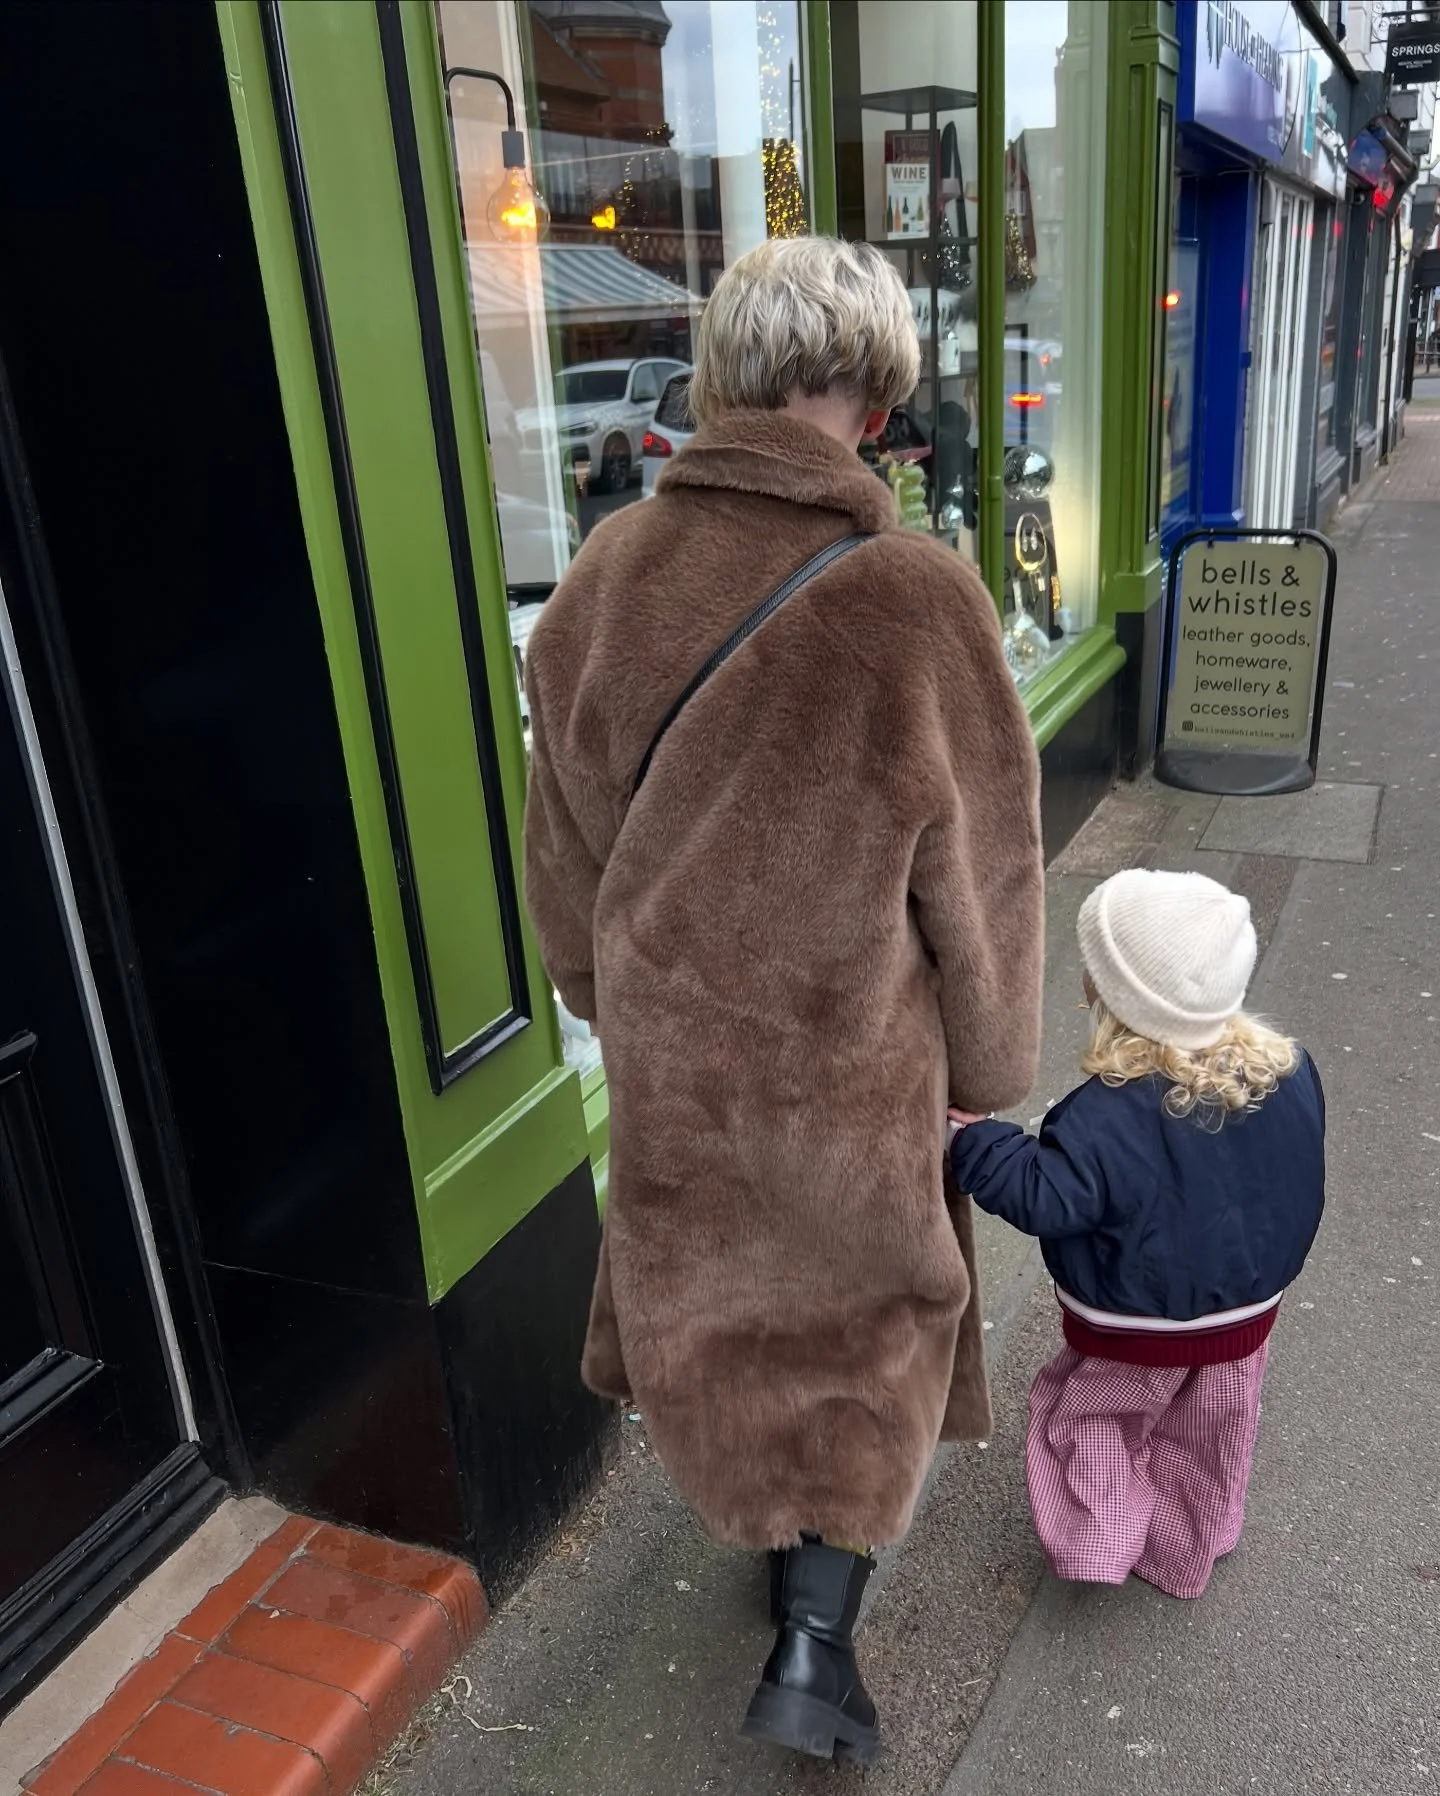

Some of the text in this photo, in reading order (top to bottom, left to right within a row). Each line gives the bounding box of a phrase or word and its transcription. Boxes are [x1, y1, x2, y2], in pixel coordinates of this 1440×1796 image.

[1391, 43, 1440, 57] SPRINGS
[1255, 32, 1284, 93] HEARING
[891, 166, 927, 180] WINE
[1201, 559, 1301, 587] bells &
[1188, 589, 1313, 618] whistles
[1182, 625, 1311, 648] leather goods,
[1195, 651, 1292, 672] homeware,
[1193, 675, 1289, 696] jewellery &
[1190, 702, 1289, 720] accessories
